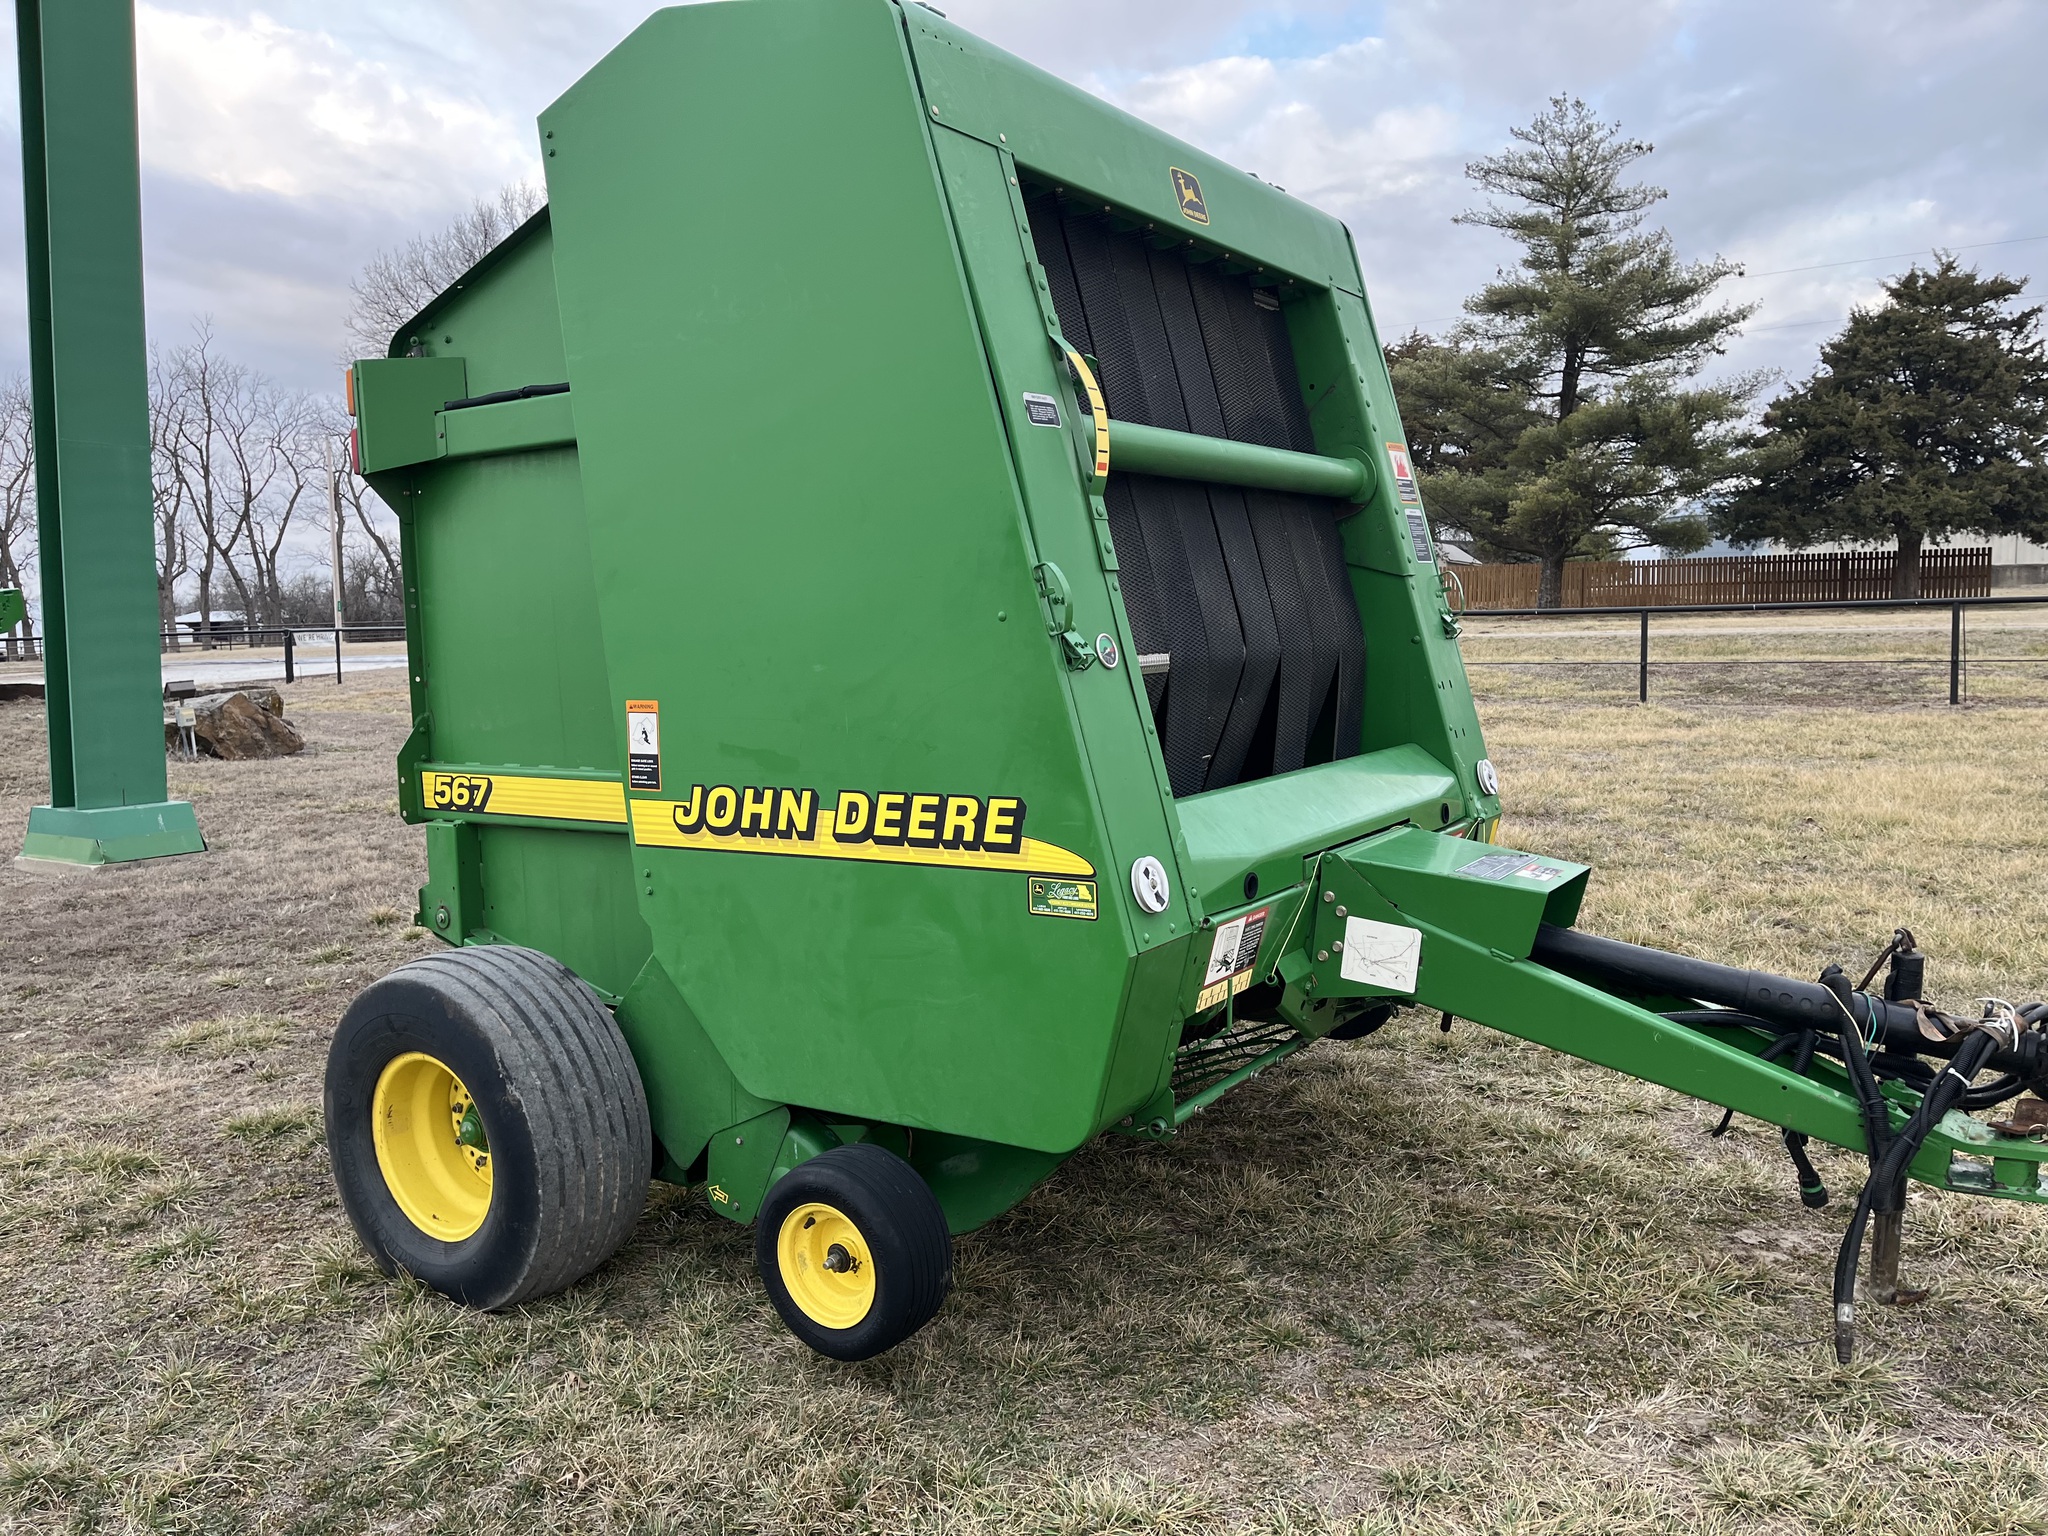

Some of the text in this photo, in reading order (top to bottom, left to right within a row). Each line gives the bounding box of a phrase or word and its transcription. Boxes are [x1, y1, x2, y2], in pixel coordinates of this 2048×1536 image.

[297, 633, 315, 641] WE'RE
[434, 775, 493, 812] 567
[674, 784, 1026, 853] JOHN DEERE
[1049, 883, 1078, 900] Legacy
